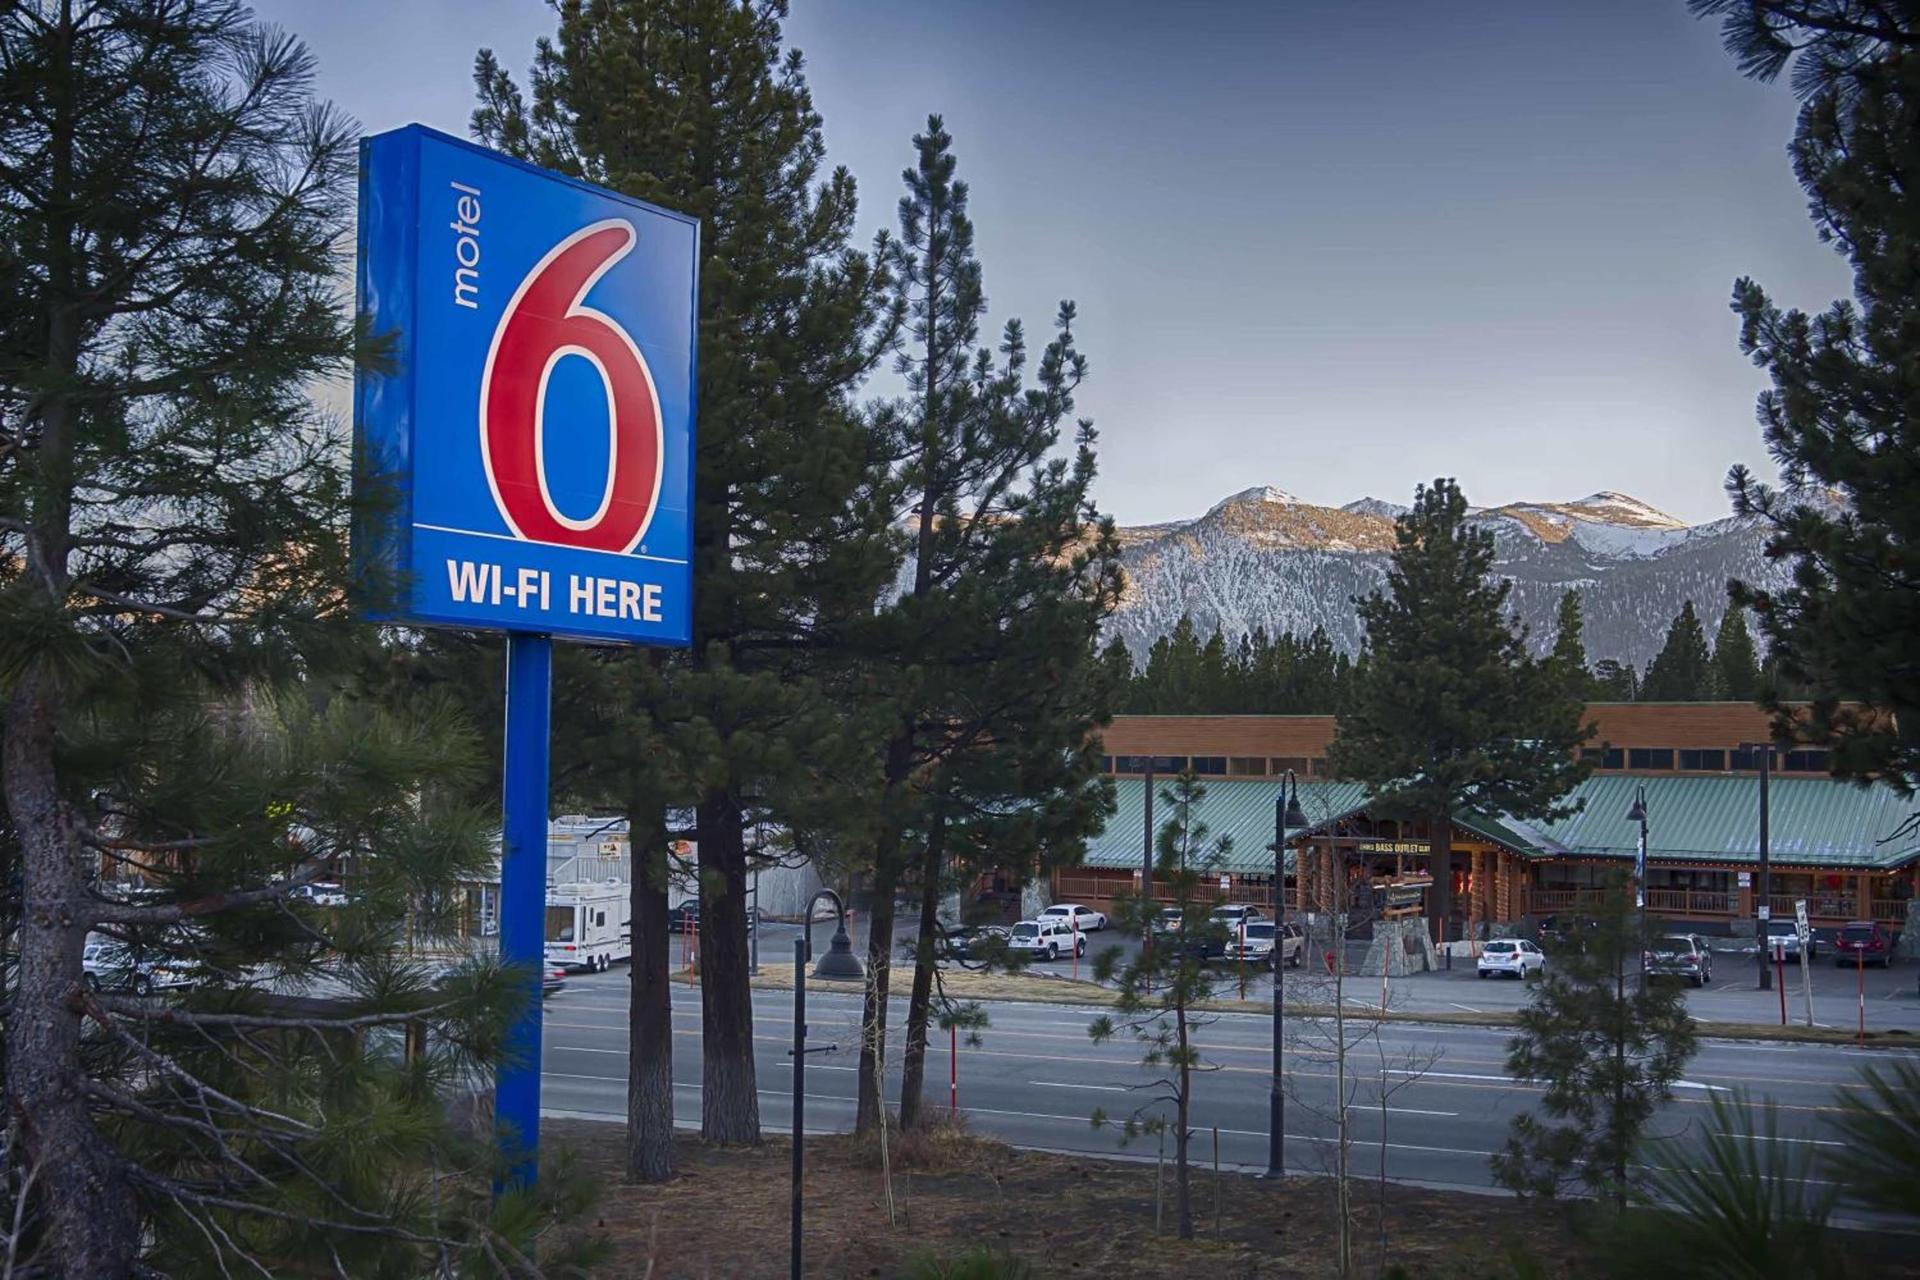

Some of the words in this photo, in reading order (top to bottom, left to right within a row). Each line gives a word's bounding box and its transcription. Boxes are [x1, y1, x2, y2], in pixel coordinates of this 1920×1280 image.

[450, 181, 481, 309] motel
[479, 217, 664, 555] 6
[446, 559, 550, 611] WI-FI
[569, 574, 662, 622] HERE
[1375, 843, 1393, 852] BASS
[1394, 843, 1418, 853] OUTLET
